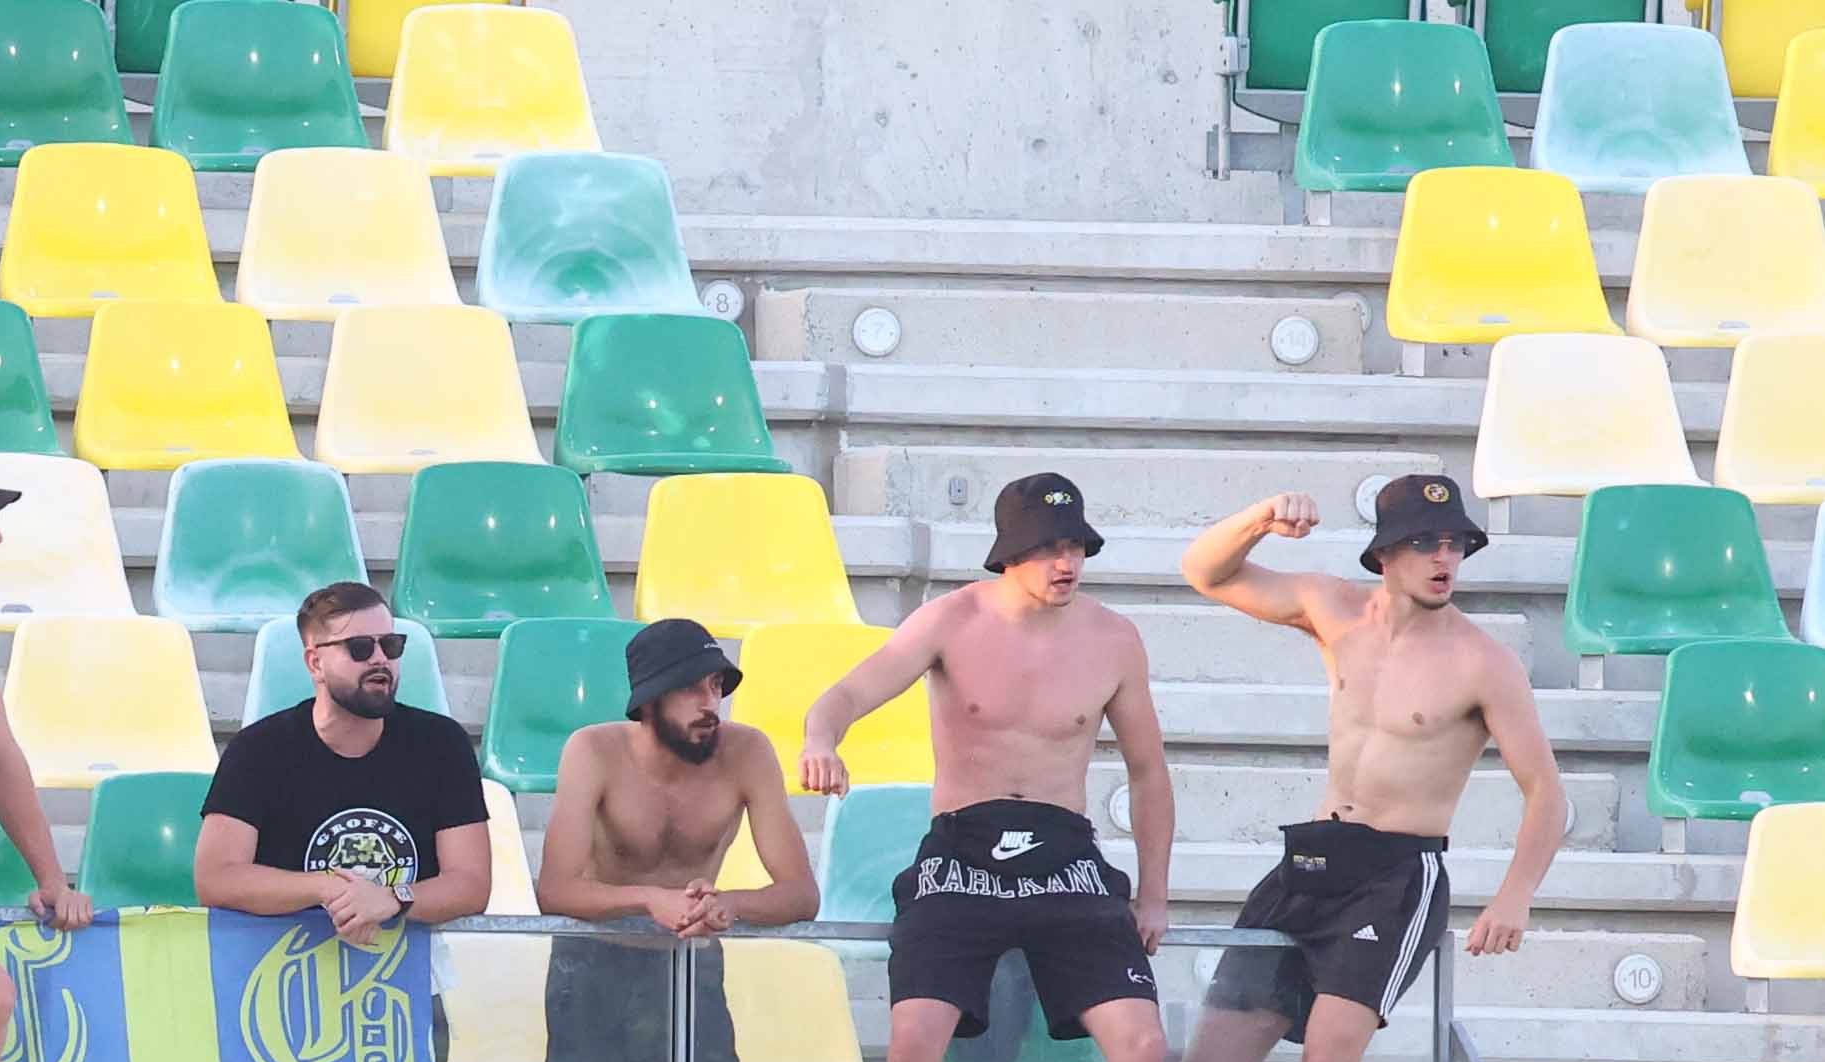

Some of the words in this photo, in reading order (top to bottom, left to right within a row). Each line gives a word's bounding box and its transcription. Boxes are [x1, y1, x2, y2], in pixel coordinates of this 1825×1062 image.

[715, 292, 730, 314] 8
[316, 818, 407, 846] GROFJE
[1000, 831, 1035, 849] NIKE
[309, 860, 327, 870] 19
[396, 856, 415, 867] 92
[1629, 967, 1652, 990] 10
